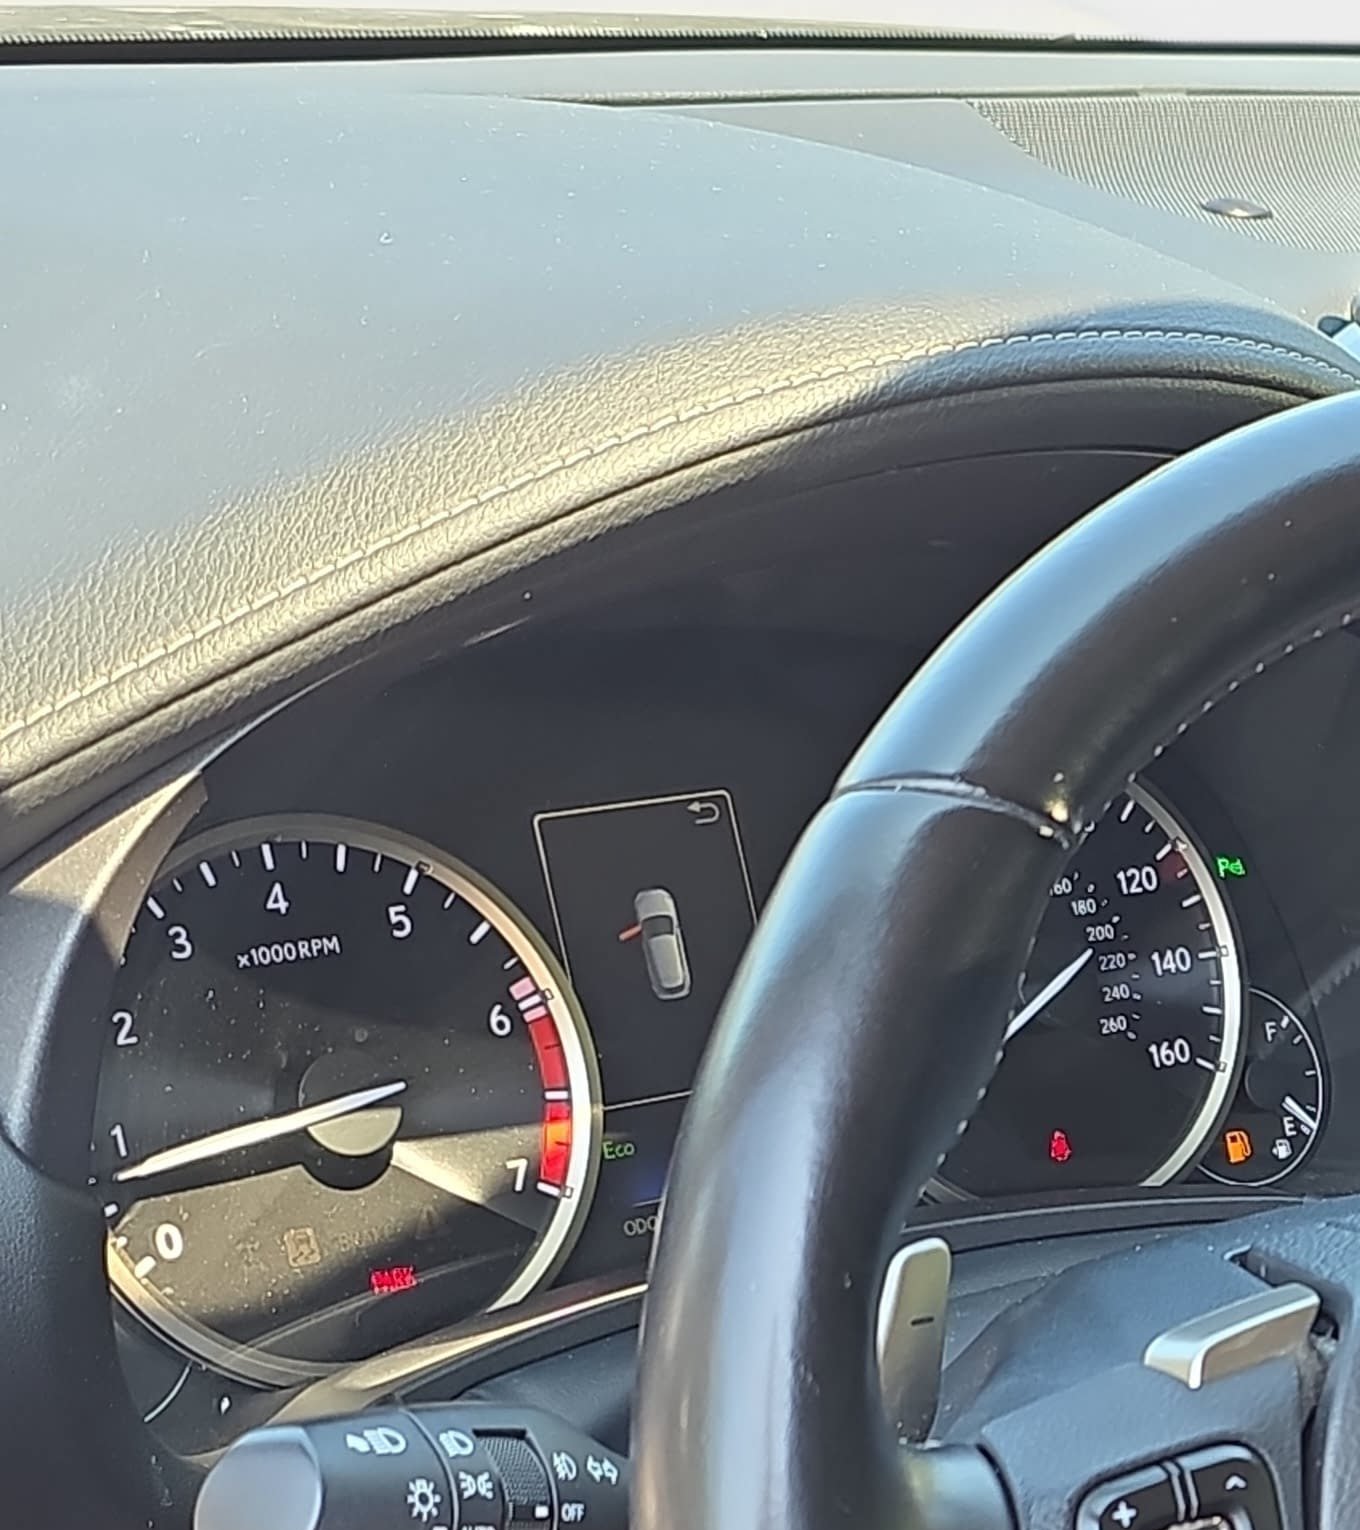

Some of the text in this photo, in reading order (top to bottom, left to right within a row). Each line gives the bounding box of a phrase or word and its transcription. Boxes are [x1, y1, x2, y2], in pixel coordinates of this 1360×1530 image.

[1116, 864, 1158, 895] 120
[265, 882, 290, 915] 4
[1071, 898, 1097, 916] 180
[388, 905, 412, 938] 5
[1085, 923, 1115, 942] 200
[168, 925, 193, 960] 3
[1098, 952, 1127, 970] 220
[1150, 946, 1192, 976] 140
[1102, 983, 1130, 1001] 240
[111, 1011, 138, 1047] 2
[489, 1004, 512, 1038] 6
[1099, 1015, 1127, 1034] 260
[1265, 1021, 1278, 1042] F
[1148, 1037, 1191, 1068] 160
[1283, 1115, 1296, 1136] E
[109, 1123, 128, 1159] 1
[602, 1140, 636, 1159] Eco
[505, 1158, 529, 1193] 7
[154, 1222, 184, 1261] 0
[560, 1502, 585, 1522] OFF
